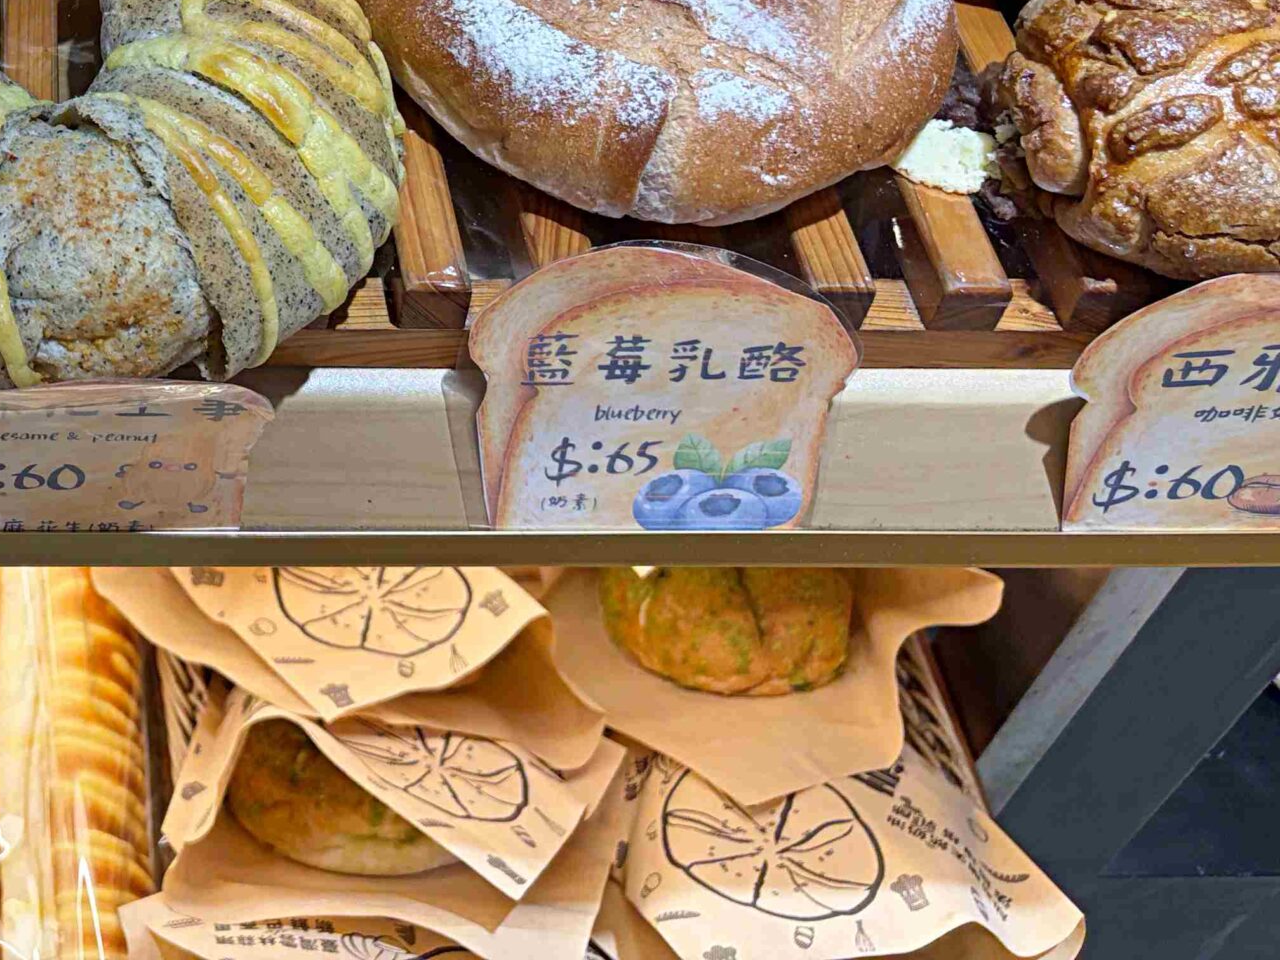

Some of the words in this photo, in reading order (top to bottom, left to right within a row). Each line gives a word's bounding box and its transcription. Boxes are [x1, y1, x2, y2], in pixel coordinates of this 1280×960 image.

[520, 331, 807, 386] 藍莓乳酪
[594, 404, 682, 423] blueberry
[67, 431, 80, 441] &
